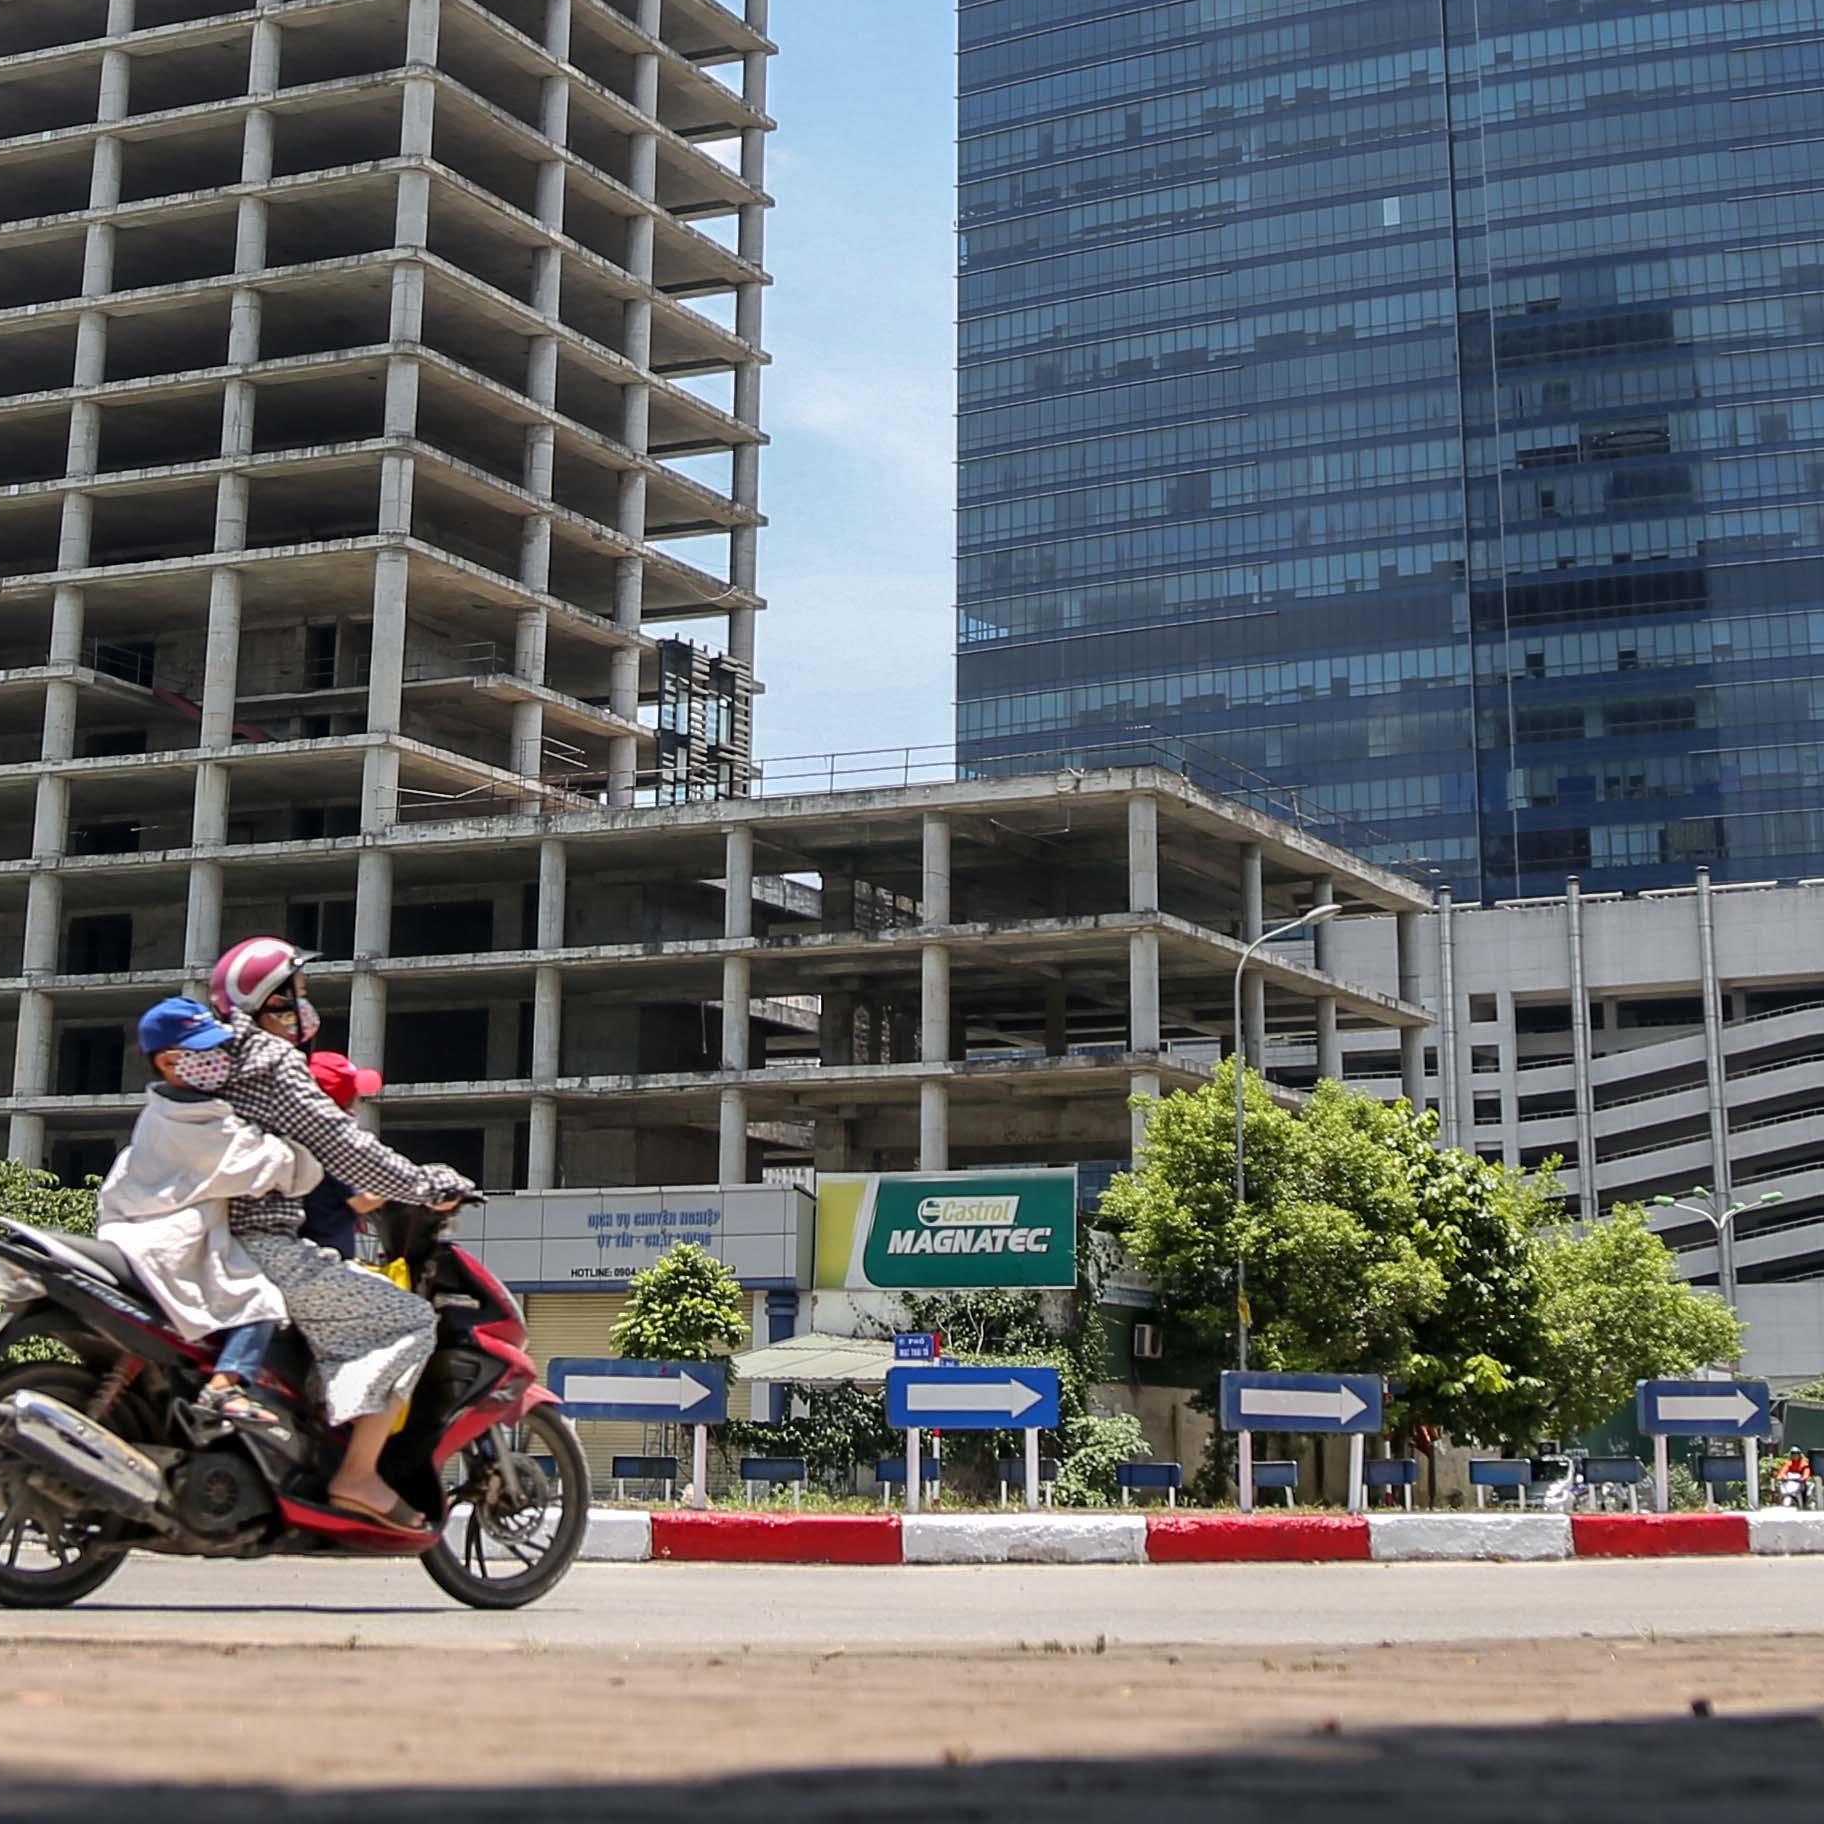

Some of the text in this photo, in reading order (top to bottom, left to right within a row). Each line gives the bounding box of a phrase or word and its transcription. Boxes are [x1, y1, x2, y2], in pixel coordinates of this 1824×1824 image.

[942, 1200, 1012, 1223] Castrol
[887, 1227, 1052, 1255] MAGNATEC
[571, 1267, 613, 1278] HOTLINE:
